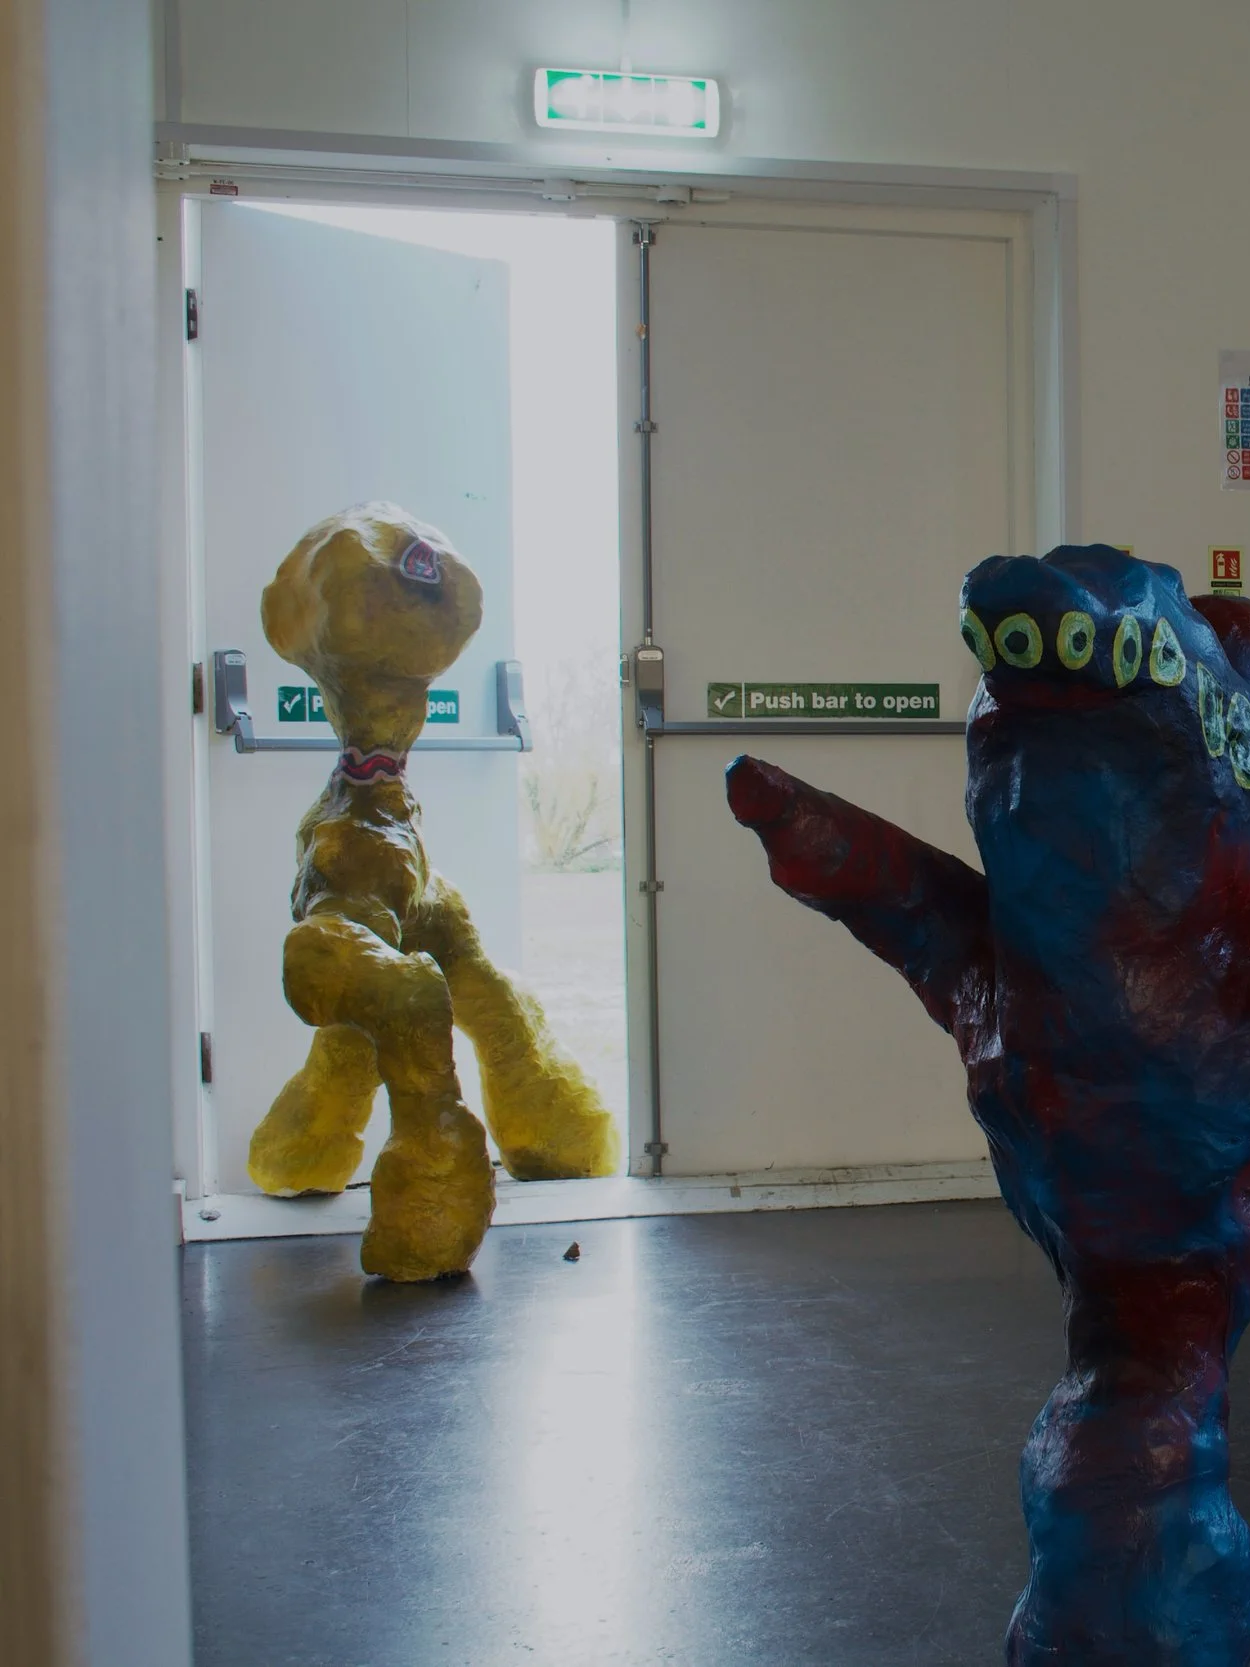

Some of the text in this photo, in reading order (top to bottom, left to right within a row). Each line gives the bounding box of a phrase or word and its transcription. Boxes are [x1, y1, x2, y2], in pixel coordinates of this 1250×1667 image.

[427, 701, 457, 718] pen
[750, 692, 936, 713] Push bar to open
